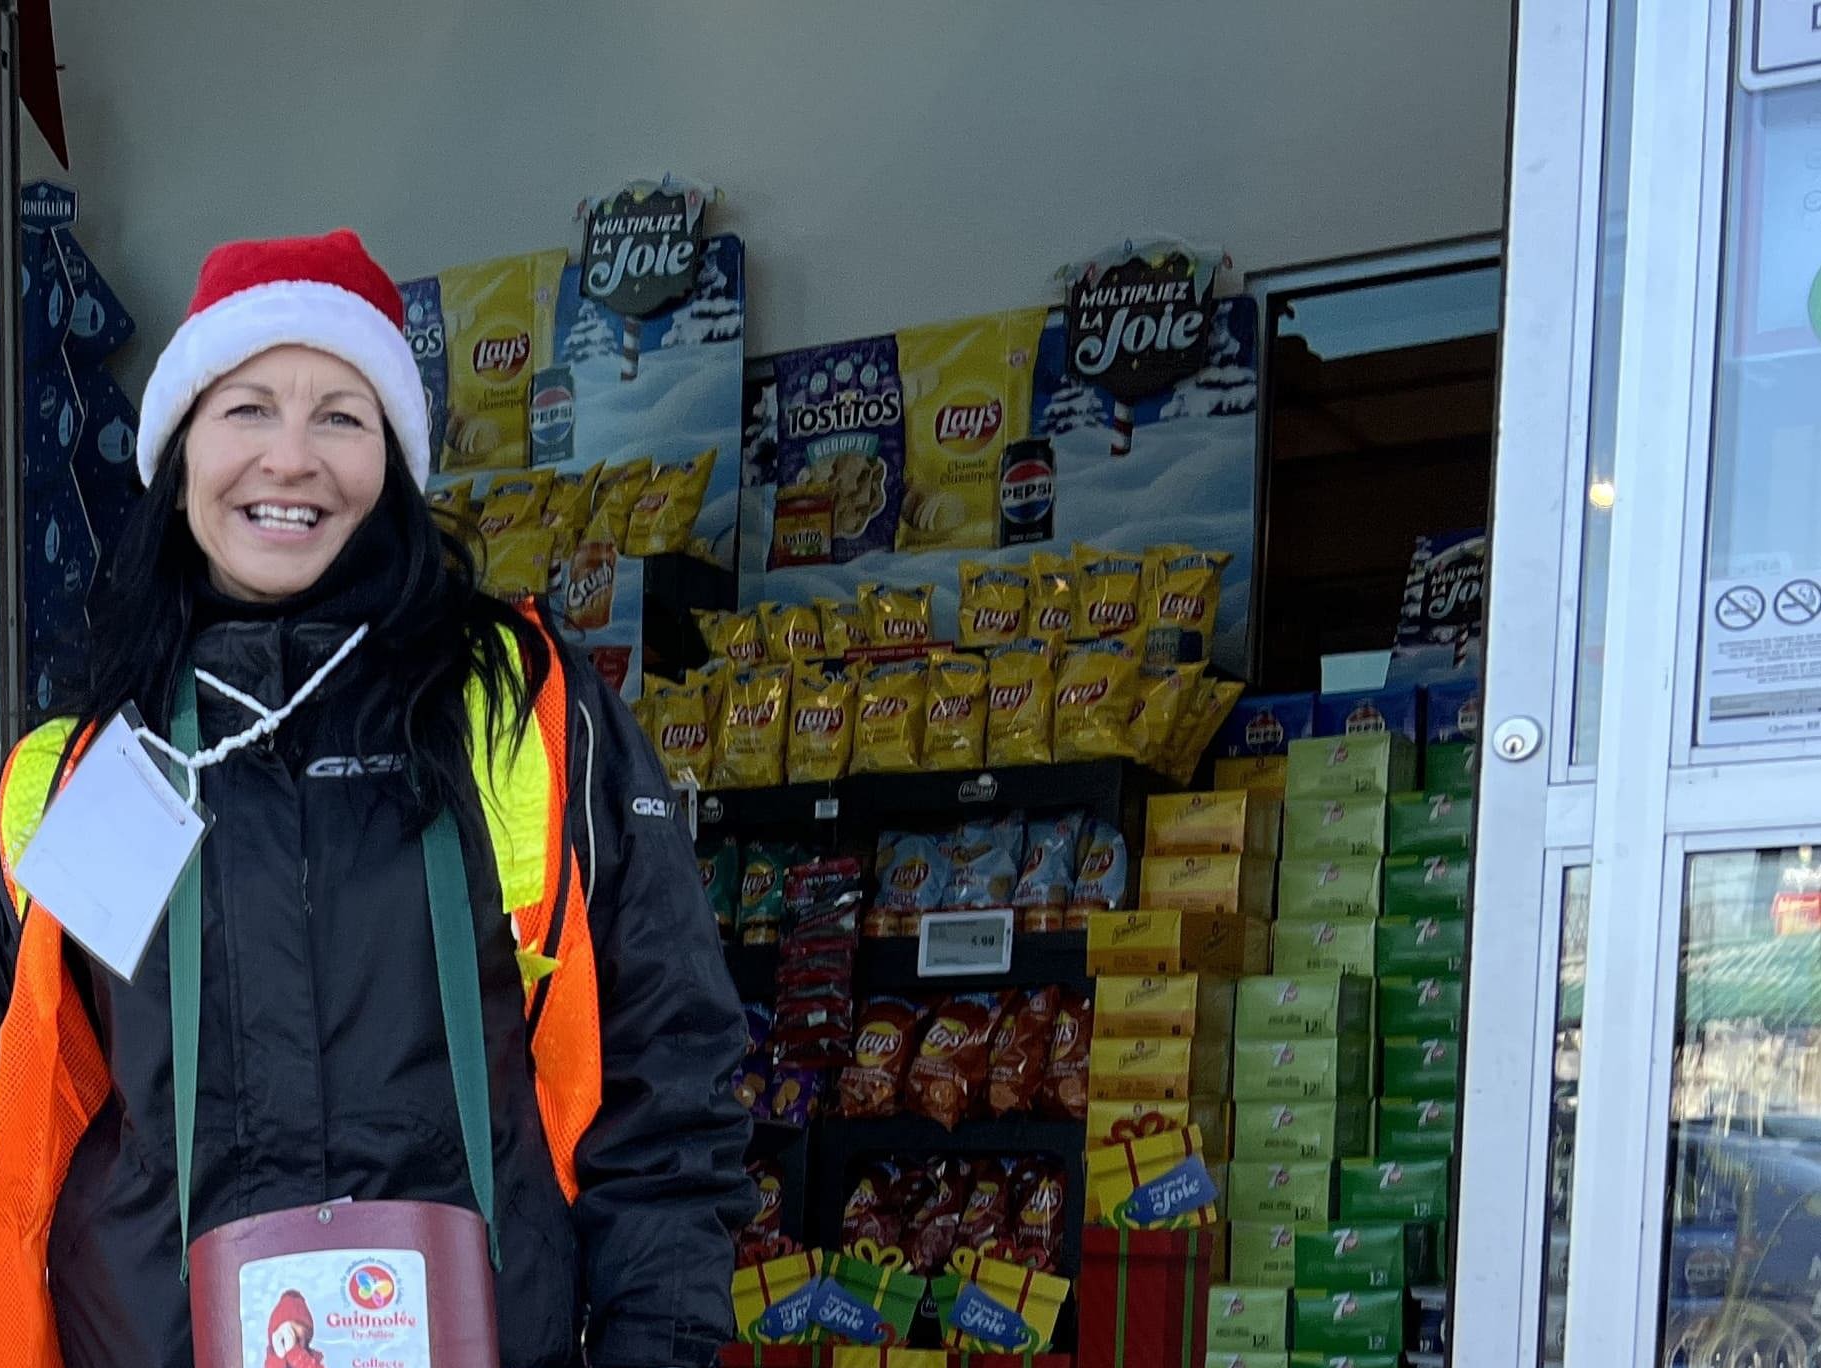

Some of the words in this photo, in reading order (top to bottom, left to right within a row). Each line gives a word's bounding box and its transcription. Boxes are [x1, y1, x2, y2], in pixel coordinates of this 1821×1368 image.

[592, 213, 685, 236] MULTIPLIEZ
[593, 238, 613, 256] LA
[588, 233, 694, 296] Joie
[1080, 281, 1190, 307] MULTIPLIEZ
[1080, 311, 1103, 329] LA
[477, 333, 529, 371] Lay's
[1074, 303, 1204, 375] Joie
[788, 388, 900, 437] TOSTITOS
[939, 398, 1000, 441] Lay's
[1002, 482, 1051, 500] PEPSI
[326, 1309, 417, 1329] Guignolée
